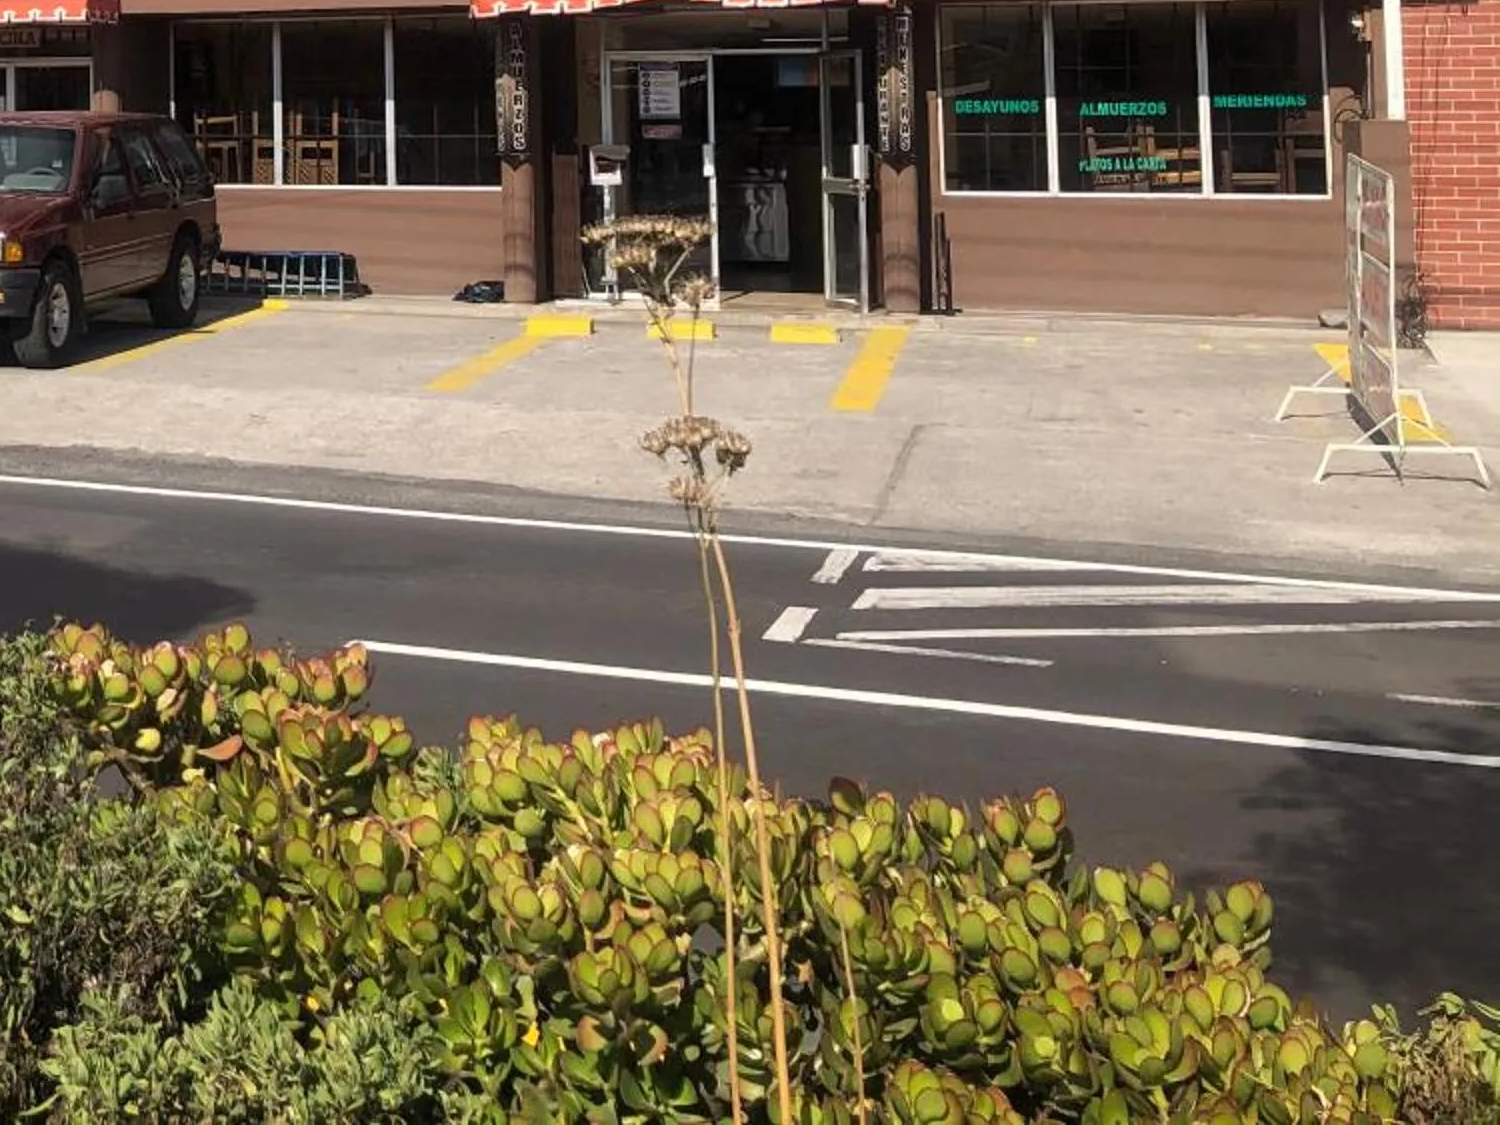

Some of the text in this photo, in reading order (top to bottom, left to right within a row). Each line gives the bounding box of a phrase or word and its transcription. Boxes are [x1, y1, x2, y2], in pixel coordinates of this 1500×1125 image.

[955, 99, 1040, 114] DESAYUNOS
[1213, 94, 1308, 108] MERIENDAS
[1079, 102, 1167, 117] ALMUERZOS
